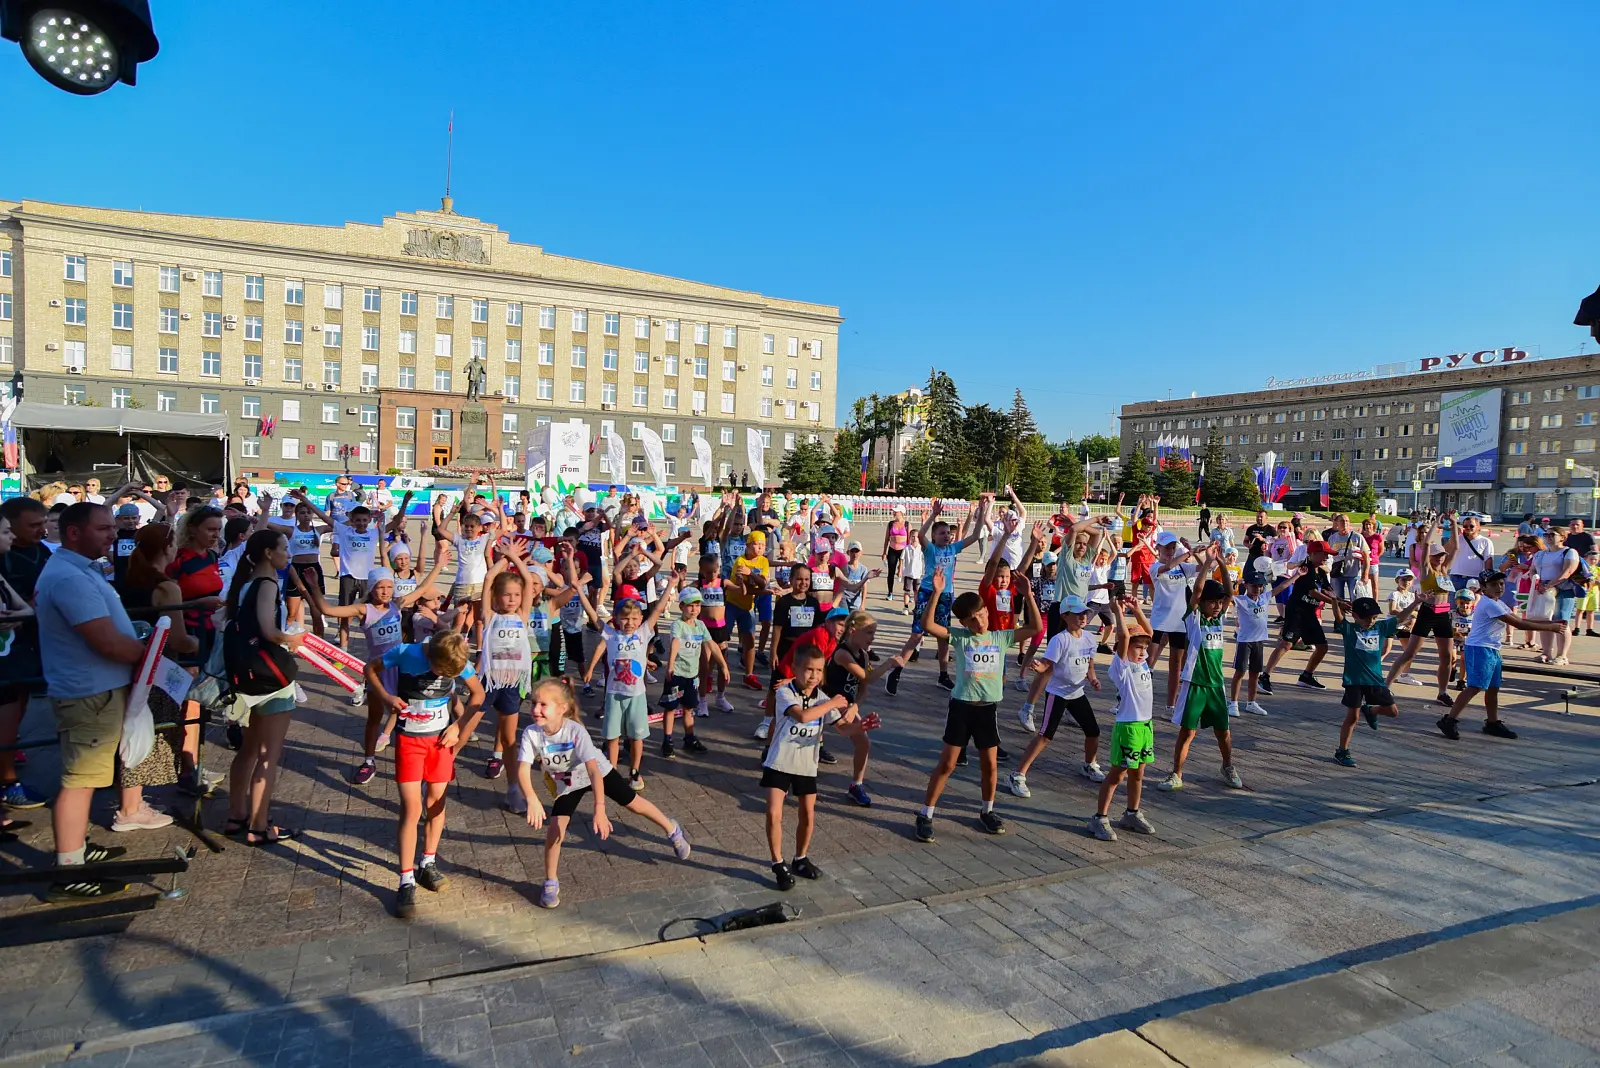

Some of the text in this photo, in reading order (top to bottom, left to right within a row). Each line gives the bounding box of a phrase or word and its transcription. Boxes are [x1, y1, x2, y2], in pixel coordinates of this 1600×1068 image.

[1419, 347, 1529, 371] РУСЬ
[560, 464, 580, 474] grom
[378, 623, 399, 636] 001
[498, 629, 521, 639] 001
[323, 646, 332, 654] ЗА
[618, 642, 636, 652] 001
[973, 653, 996, 663] 001
[789, 725, 813, 738] 001
